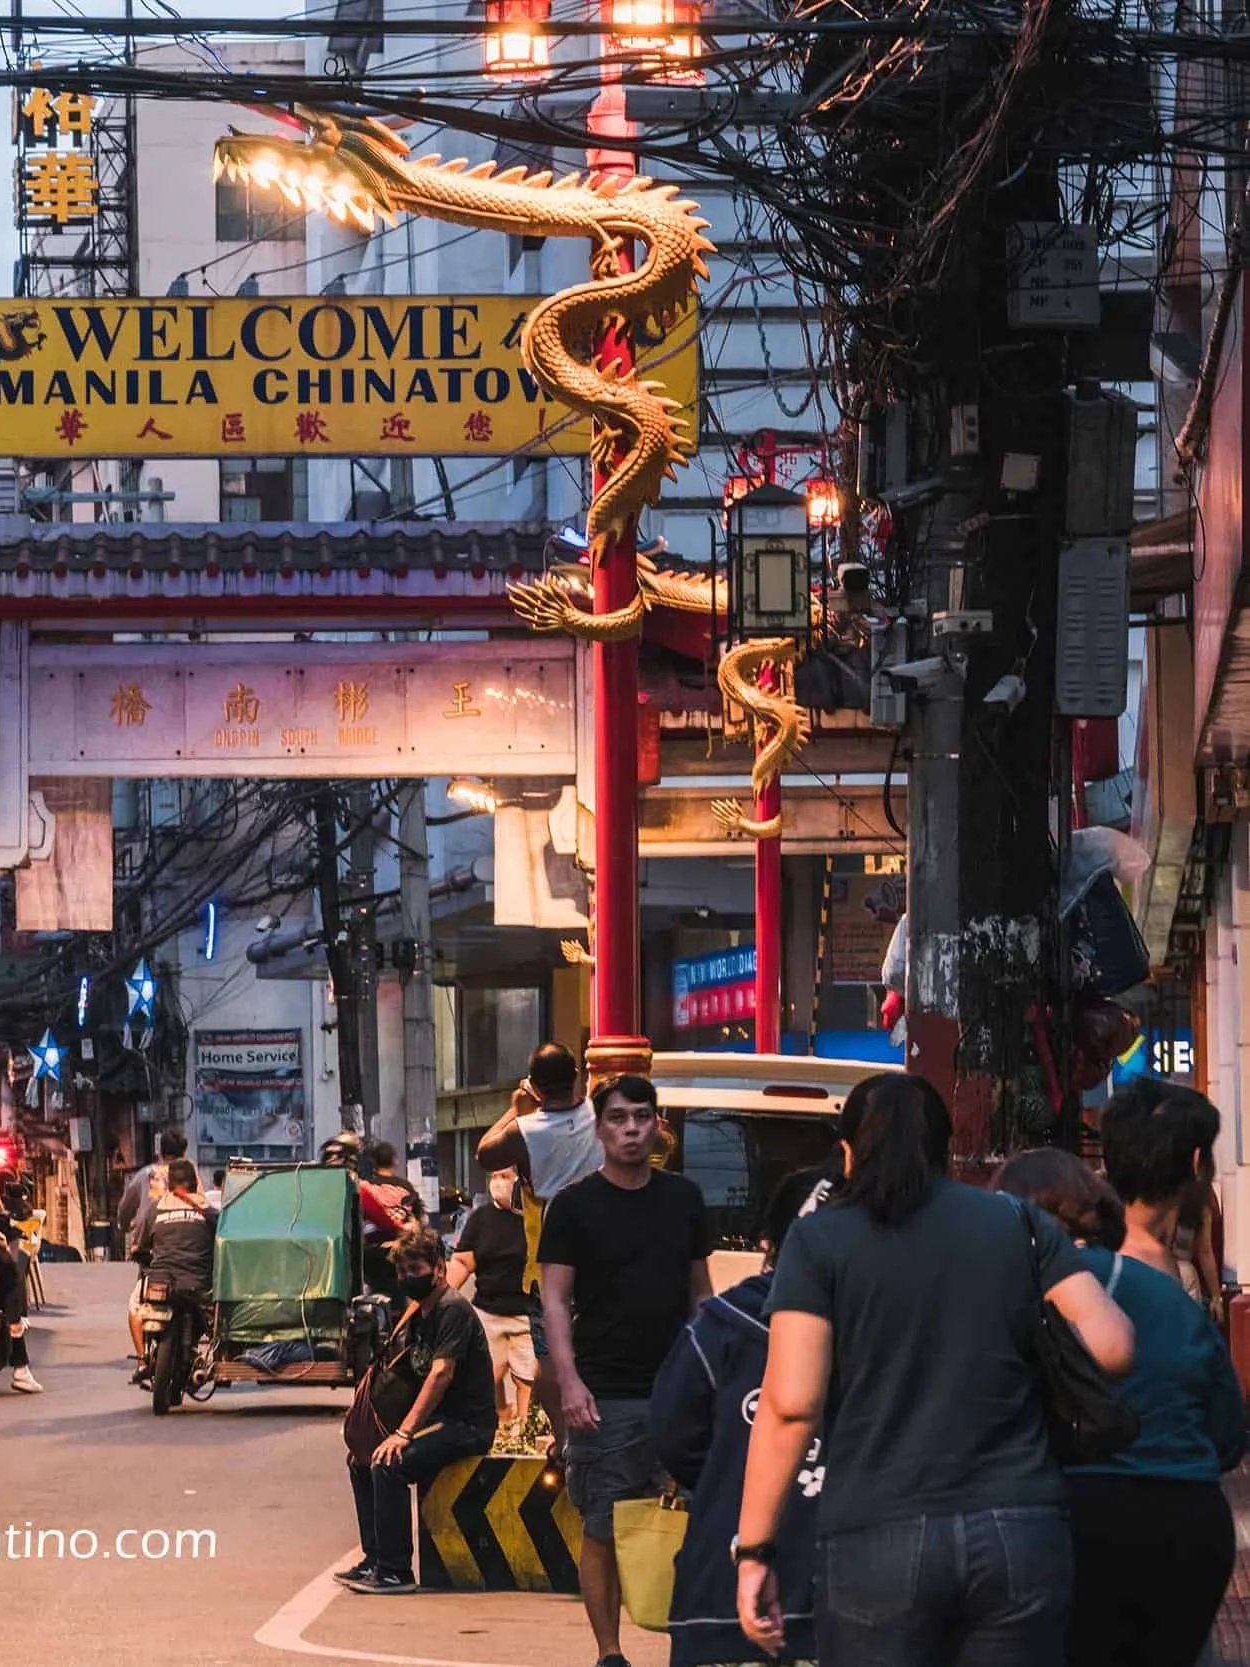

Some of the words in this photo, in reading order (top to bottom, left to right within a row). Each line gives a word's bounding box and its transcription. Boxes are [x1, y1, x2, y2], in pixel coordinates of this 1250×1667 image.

[52, 305, 482, 363] WELCOME
[201, 1050, 243, 1063] Home
[247, 1048, 296, 1063] Service
